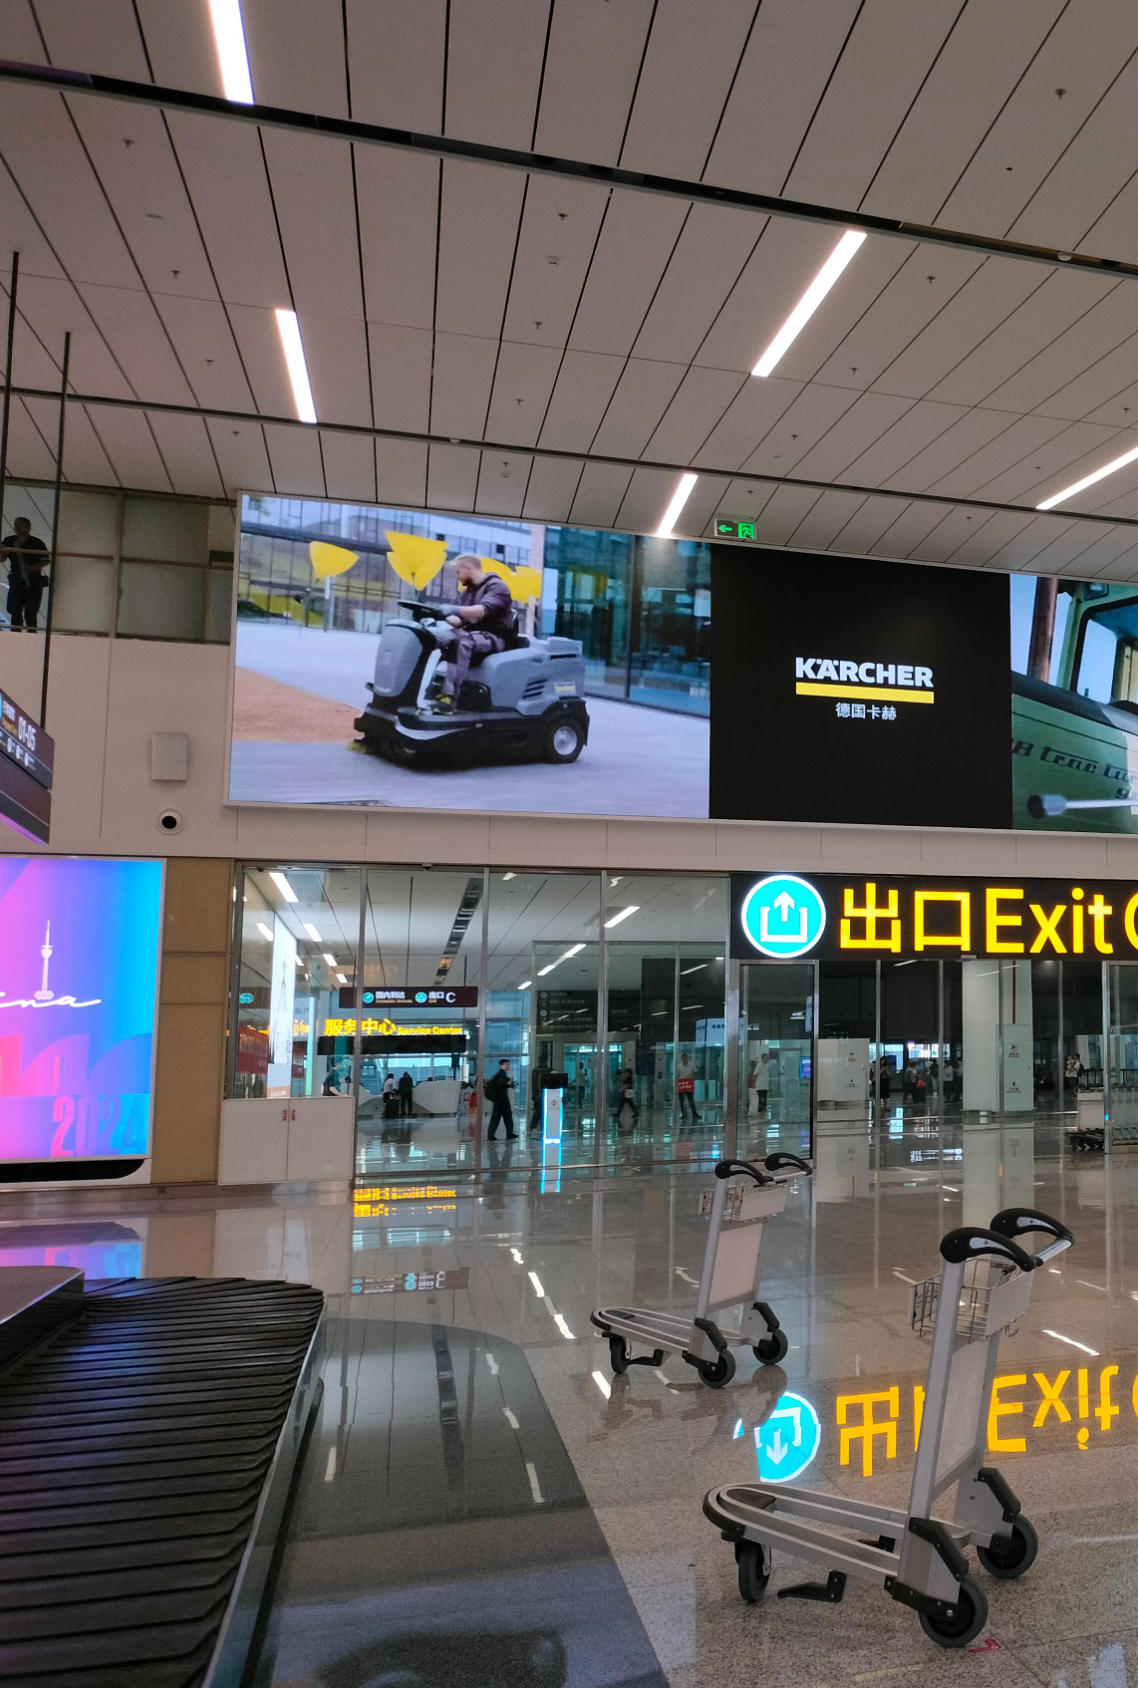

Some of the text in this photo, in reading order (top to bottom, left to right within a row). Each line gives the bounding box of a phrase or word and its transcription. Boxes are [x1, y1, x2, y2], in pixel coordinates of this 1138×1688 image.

[795, 657, 934, 688] KÄRCHER
[835, 702, 897, 721] 德国卡赫
[840, 882, 972, 953] 出口
[985, 887, 1115, 954] Exit
[446, 992, 456, 1003] C
[325, 1018, 396, 1036] 服务中心
[51, 1095, 149, 1158] 2024
